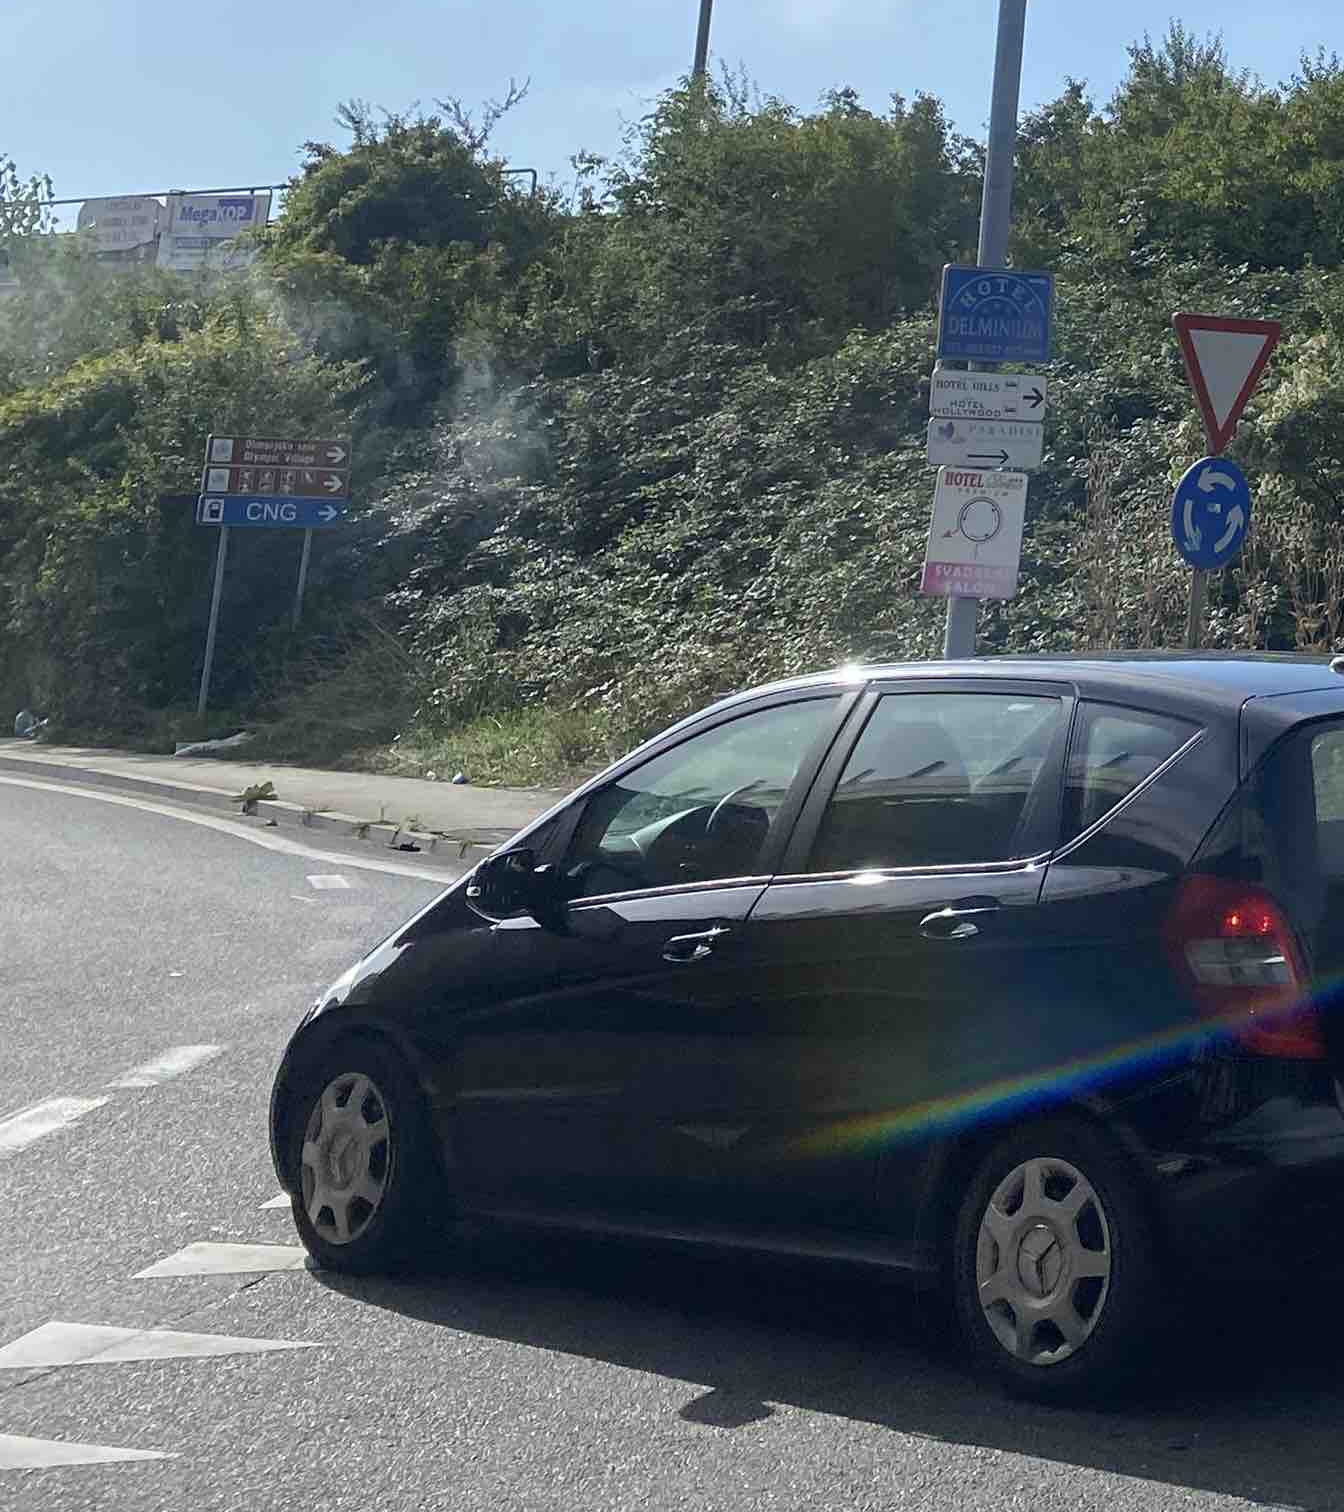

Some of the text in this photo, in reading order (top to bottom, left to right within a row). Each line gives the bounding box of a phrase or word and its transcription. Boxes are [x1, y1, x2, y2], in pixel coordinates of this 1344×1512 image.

[960, 279, 1035, 312] HOTEL
[936, 380, 967, 391] HOTEL
[950, 400, 984, 409] HOTEL
[933, 407, 1002, 417] HOLLYWOOD
[944, 471, 984, 488] HOTEL
[246, 502, 297, 521] CNG
